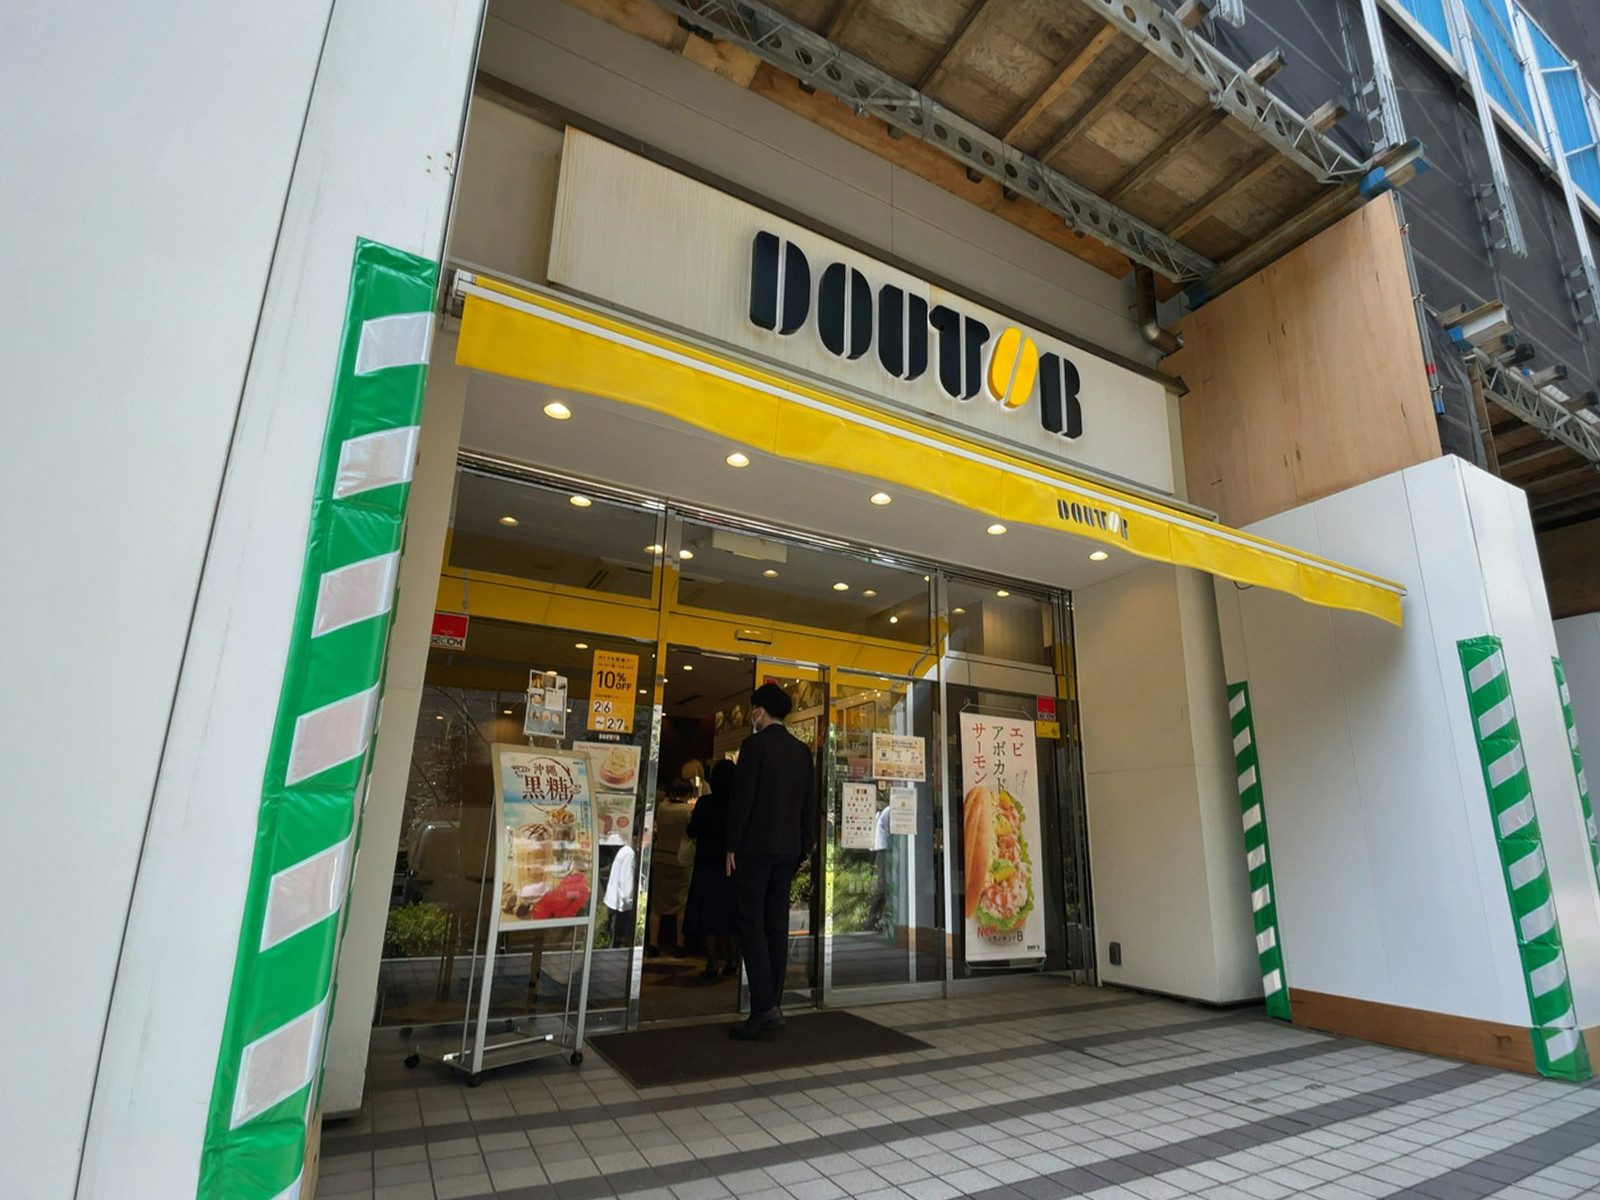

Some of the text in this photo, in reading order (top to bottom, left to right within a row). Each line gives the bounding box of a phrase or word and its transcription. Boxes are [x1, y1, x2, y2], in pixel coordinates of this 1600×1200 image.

[750, 230, 1083, 440] DOUTOR
[1057, 499, 1128, 540] DOUTOR
[616, 683, 632, 691] OFF
[594, 701, 611, 713] 26
[972, 723, 988, 784] サーモン
[992, 725, 1007, 794] アボカド
[1010, 727, 1024, 757] エビ
[522, 775, 569, 801] 黒糖
